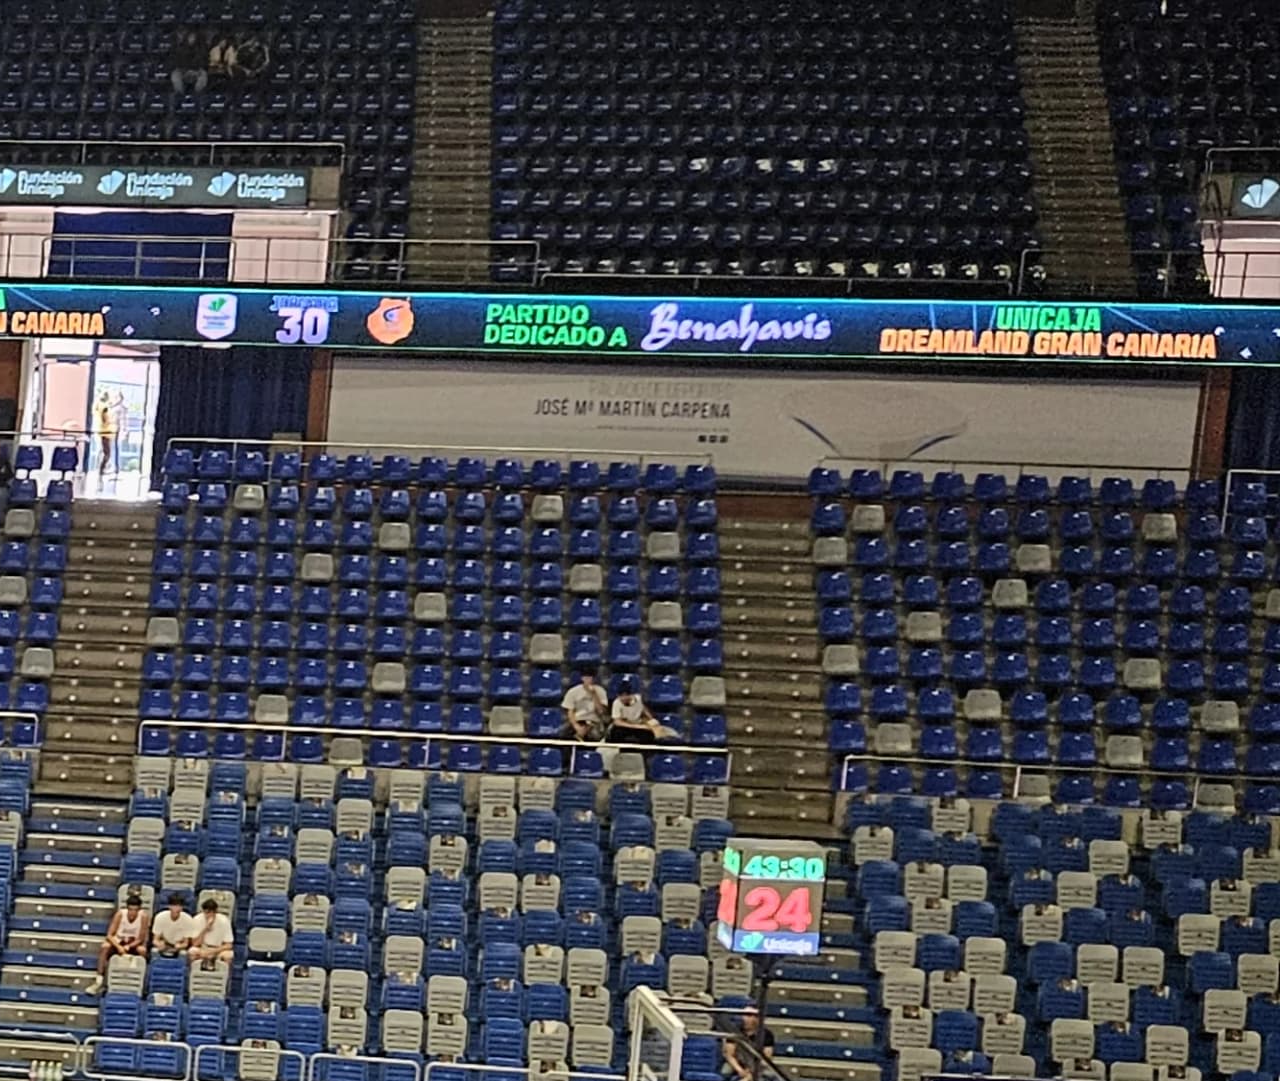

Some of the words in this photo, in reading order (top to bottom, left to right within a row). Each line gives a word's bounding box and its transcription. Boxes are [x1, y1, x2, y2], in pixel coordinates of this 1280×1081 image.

[18, 169, 83, 184] Fundación
[126, 172, 192, 187] Fundación
[238, 172, 304, 188] Fundación
[17, 180, 65, 198] Unicaja
[126, 183, 174, 200] Unicaja
[238, 185, 287, 201] Unicaja
[11, 312, 104, 335] CANARIA
[486, 304, 589, 324] PARTIDO
[997, 305, 1101, 331] UNICAJA
[275, 309, 329, 344] 30
[484, 325, 605, 346] DEDICADO
[608, 329, 628, 347] A
[879, 329, 1028, 354] DREAMLAND
[1033, 332, 1102, 357] GRAN
[1107, 334, 1216, 359] CANARIA
[535, 398, 568, 415] JOSÉ
[661, 401, 731, 418] CARPENA
[743, 855, 824, 878] 43:30
[742, 887, 812, 932] 24
